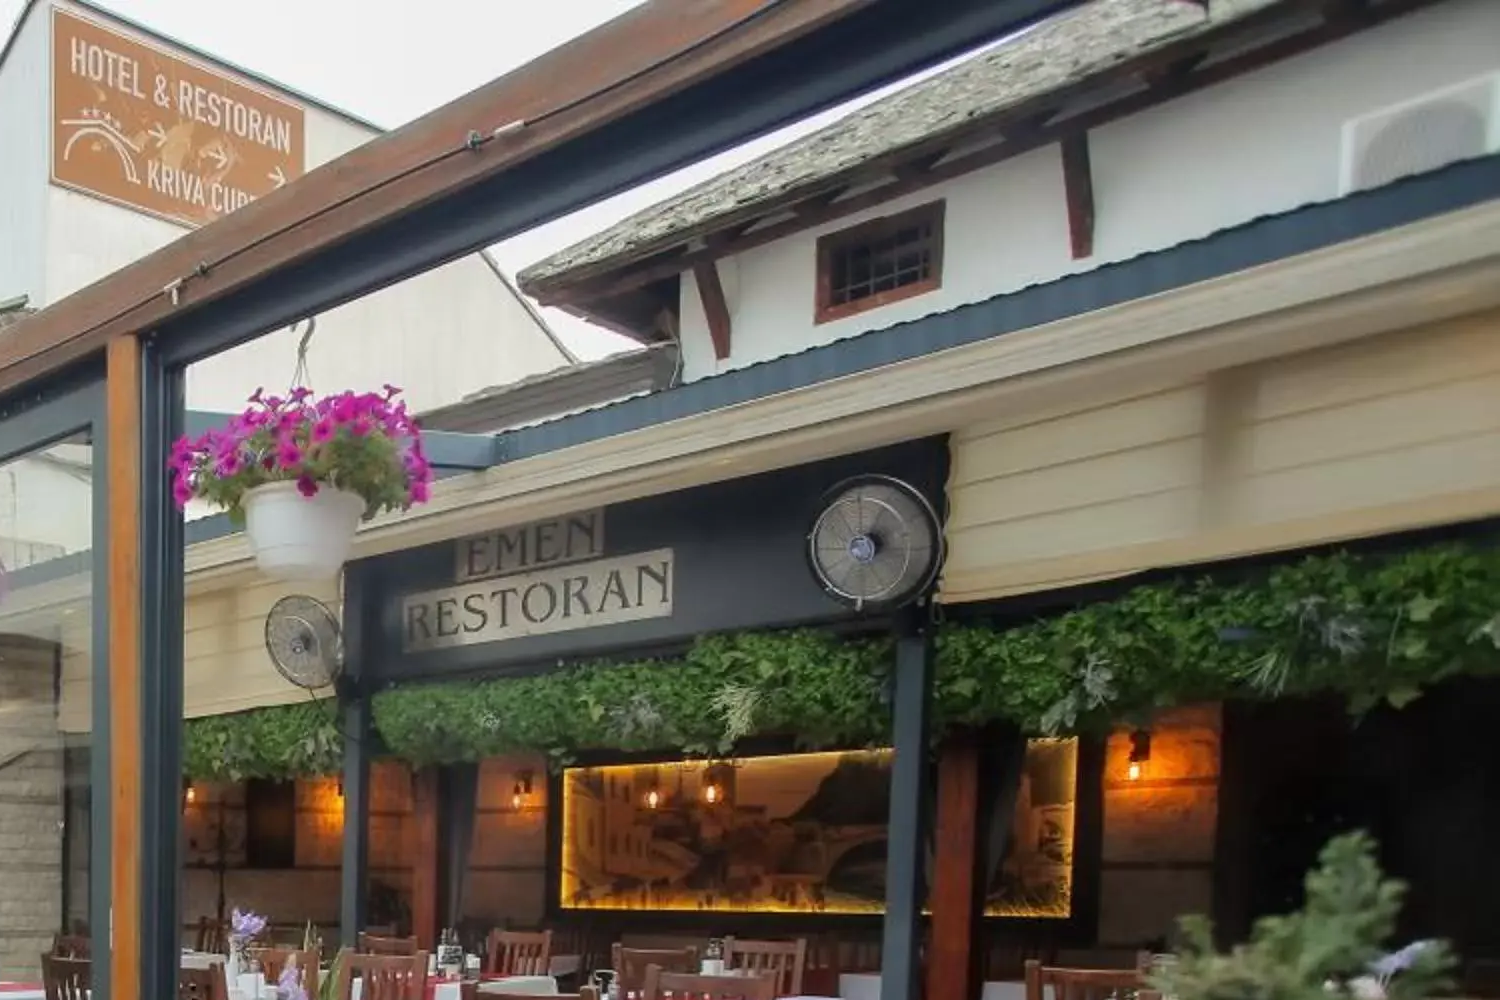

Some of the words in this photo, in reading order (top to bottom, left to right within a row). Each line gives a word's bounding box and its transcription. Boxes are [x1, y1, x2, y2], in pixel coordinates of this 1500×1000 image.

[71, 36, 146, 100] HOTEL
[153, 73, 170, 109] &
[179, 79, 291, 155] RESTORAN
[147, 159, 206, 207] KRIVA
[466, 511, 598, 578] EMEN
[407, 560, 670, 643] RESTORAN
